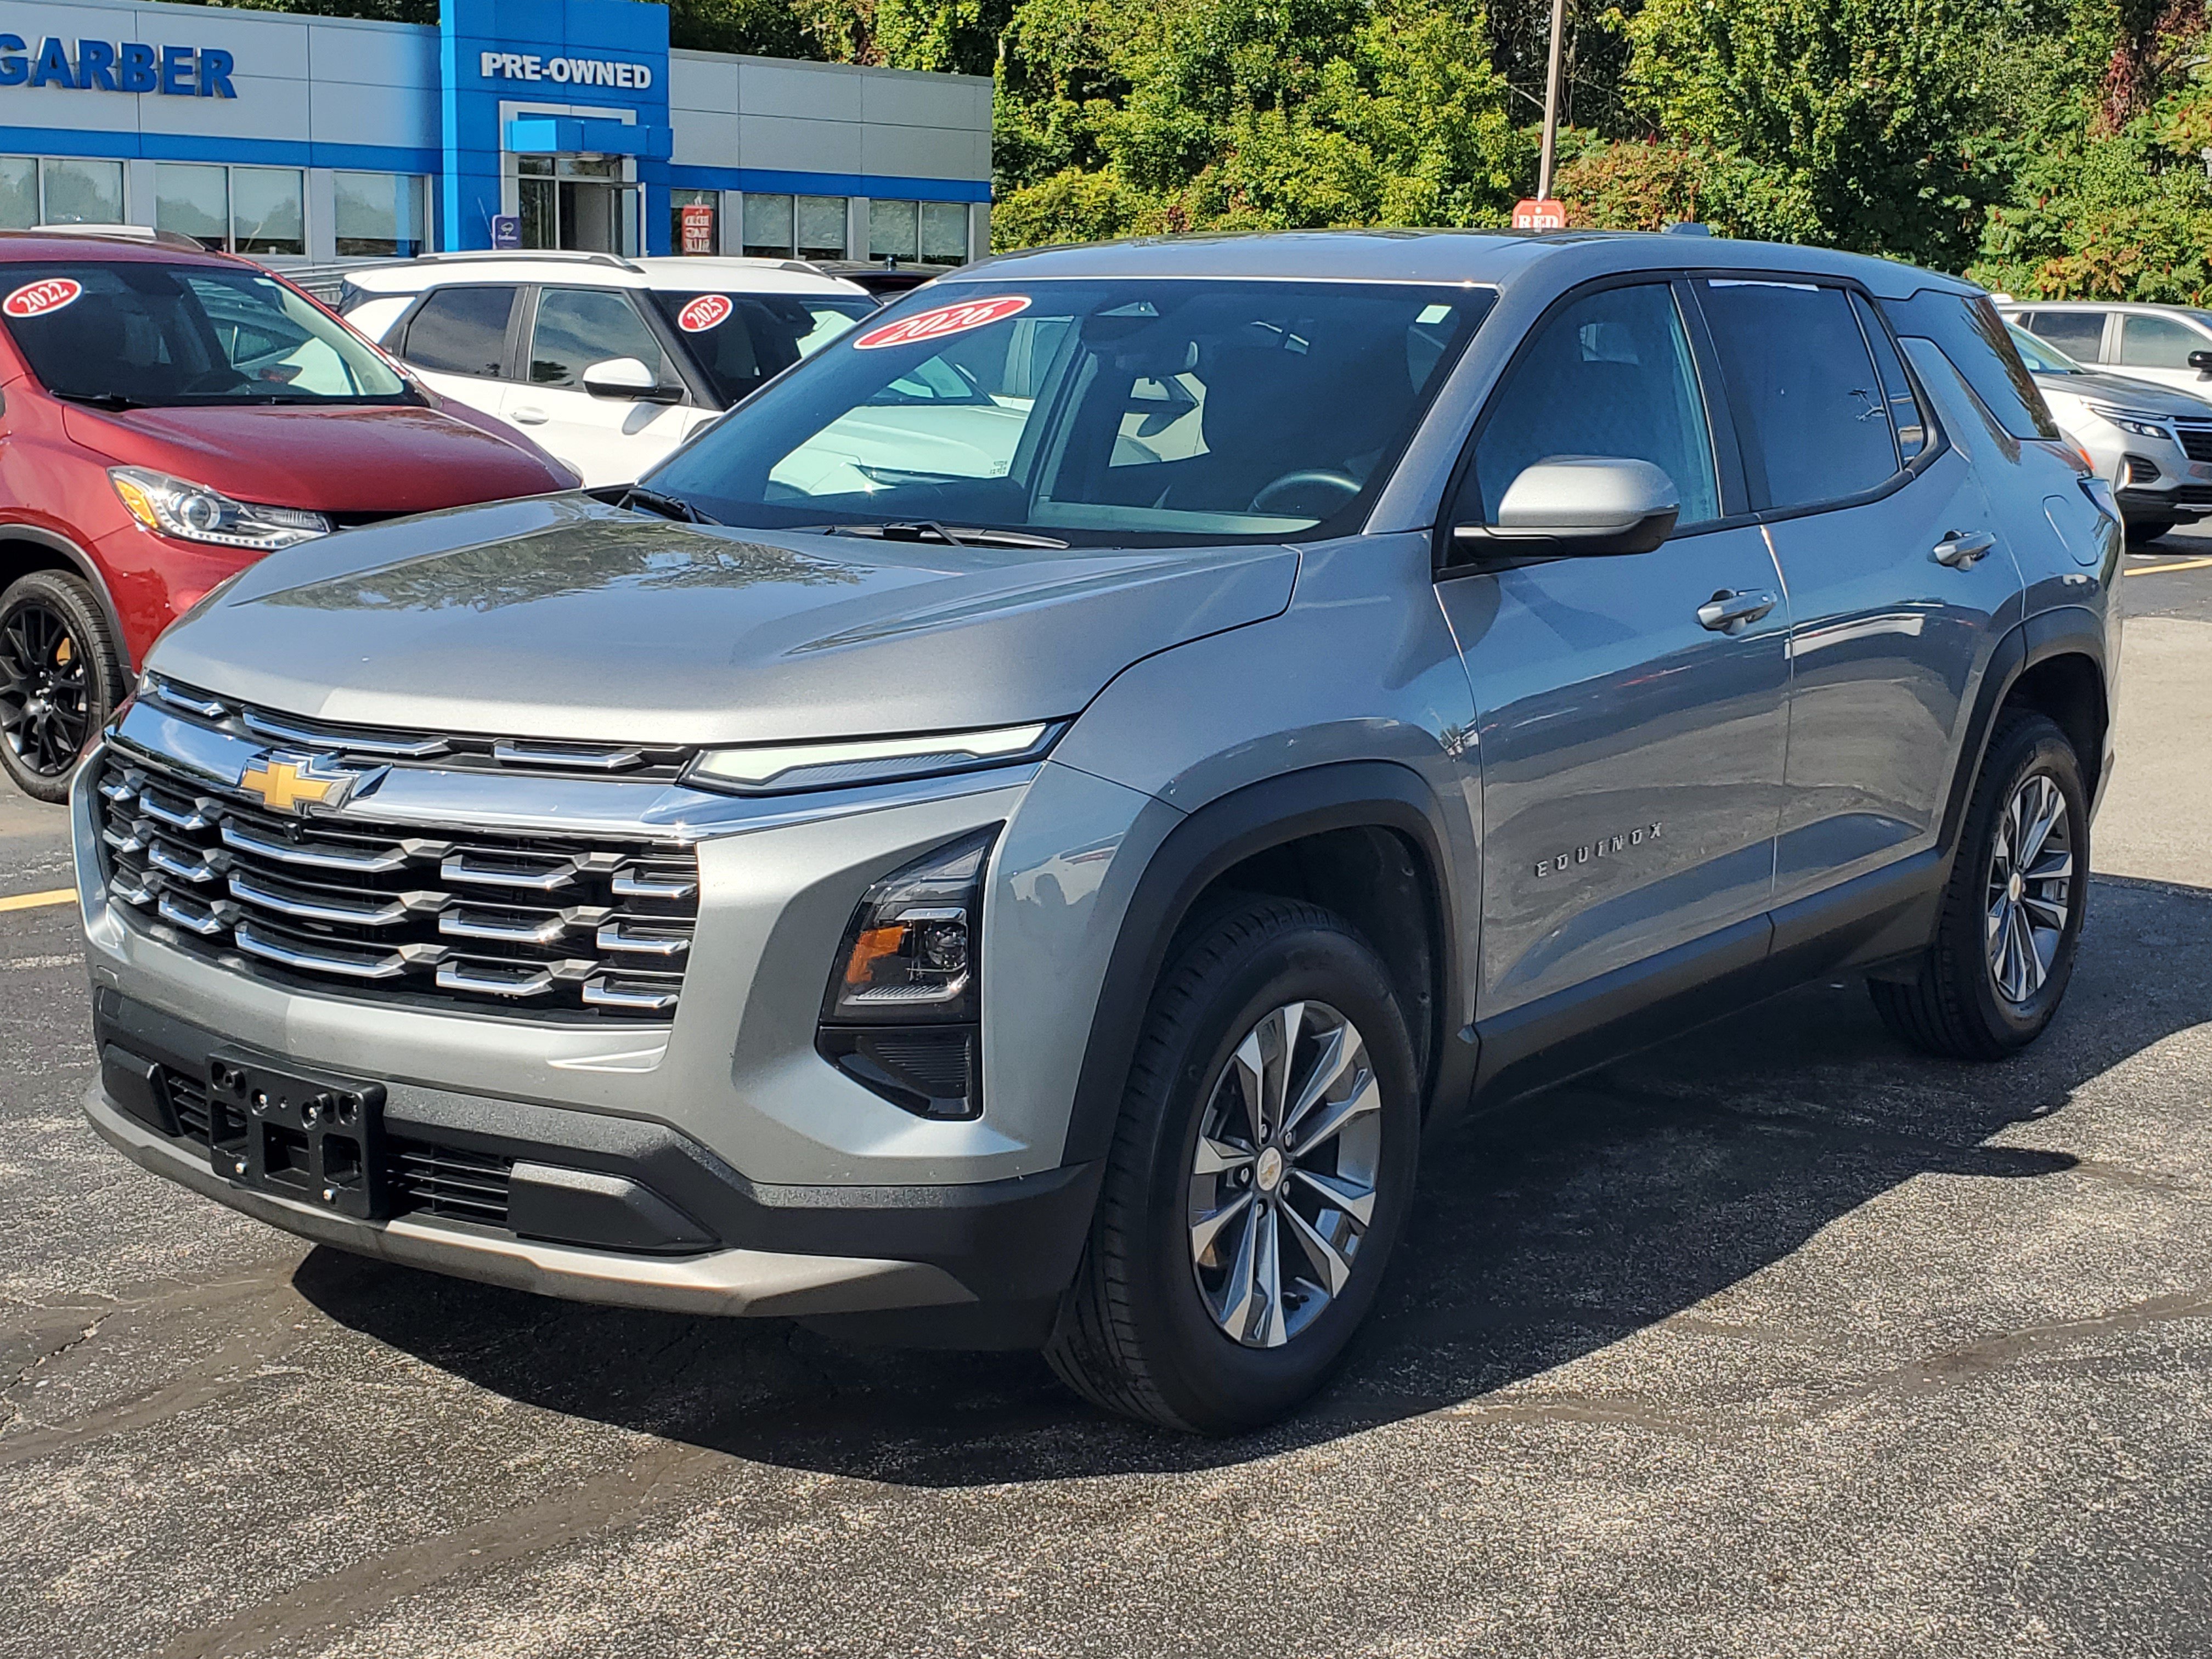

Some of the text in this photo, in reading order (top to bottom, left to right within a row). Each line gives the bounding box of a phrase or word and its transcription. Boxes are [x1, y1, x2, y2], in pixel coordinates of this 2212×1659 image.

[0, 34, 237, 99] GARBER
[481, 52, 652, 88] PRE-OWNED
[1518, 215, 1559, 228] RED
[16, 283, 70, 313] 2022
[687, 298, 724, 328] 2025
[874, 301, 1009, 345] 2026
[1536, 822, 1662, 877] EQUINOX
